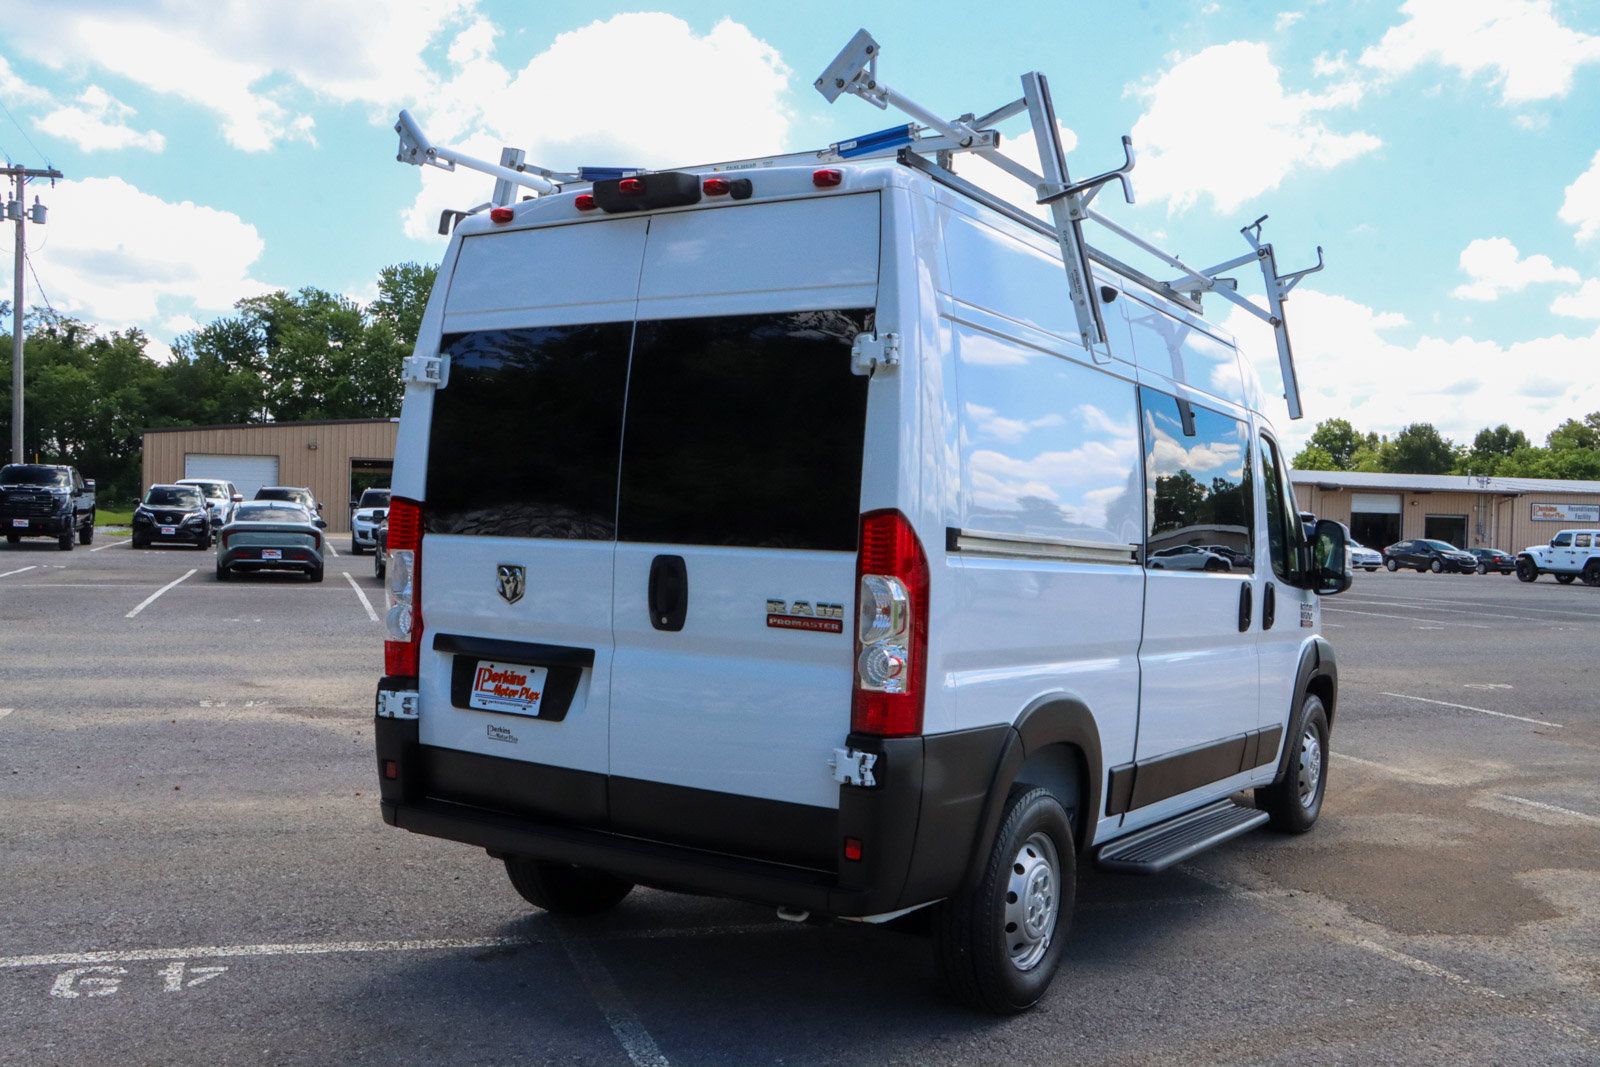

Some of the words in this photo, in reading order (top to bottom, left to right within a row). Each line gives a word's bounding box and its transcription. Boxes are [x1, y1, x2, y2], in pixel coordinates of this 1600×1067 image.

[767, 599, 843, 618] RAM
[768, 617, 840, 632] PROMASTER
[475, 667, 527, 689] Perkins
[494, 684, 519, 697] Motor
[519, 687, 540, 702] Plex
[487, 725, 511, 735] Perkins
